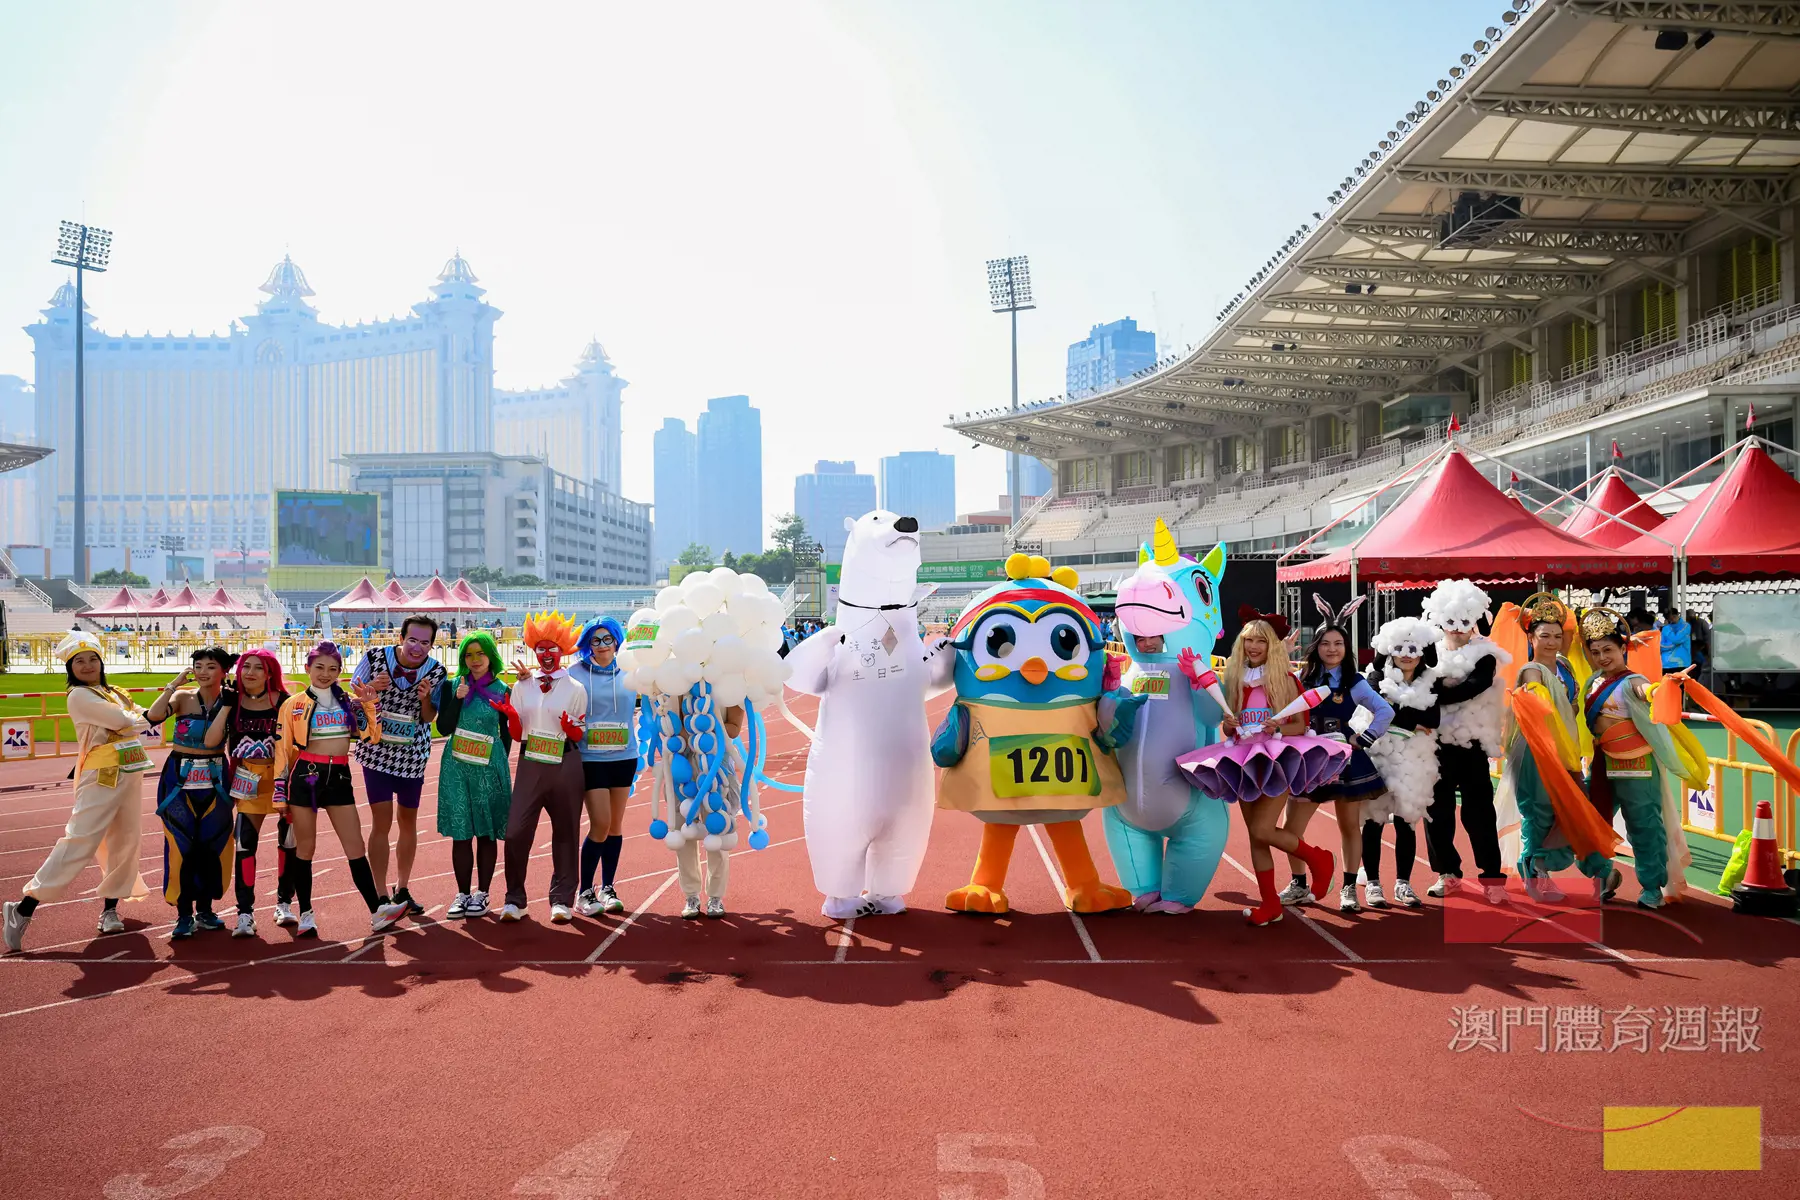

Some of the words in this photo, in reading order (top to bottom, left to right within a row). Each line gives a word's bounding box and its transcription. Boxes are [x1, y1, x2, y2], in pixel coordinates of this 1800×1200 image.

[382, 720, 412, 736] B4245
[592, 730, 624, 744] C8294
[456, 738, 487, 757] C5063
[529, 738, 559, 755] C5015
[1007, 746, 1088, 783] 1207
[103, 1126, 266, 1200] 3
